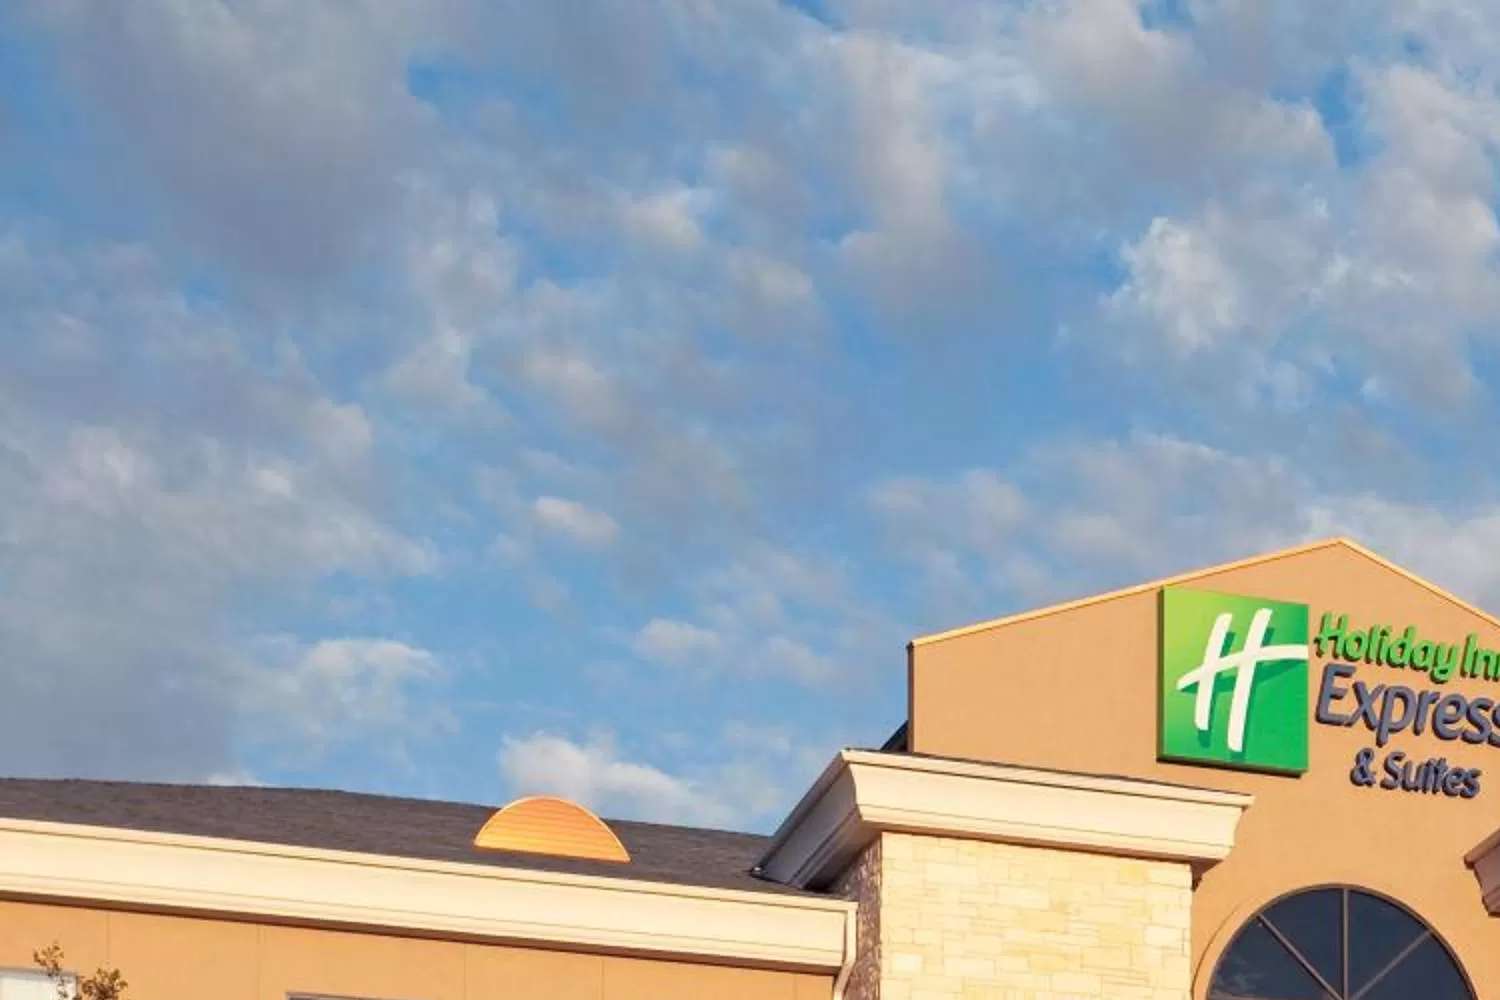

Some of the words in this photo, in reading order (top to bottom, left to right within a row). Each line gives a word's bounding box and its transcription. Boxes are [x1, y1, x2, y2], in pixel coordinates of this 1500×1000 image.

[1314, 611, 1459, 684] Holiday
[1350, 747, 1376, 788] &
[1380, 751, 1483, 798] Suites
